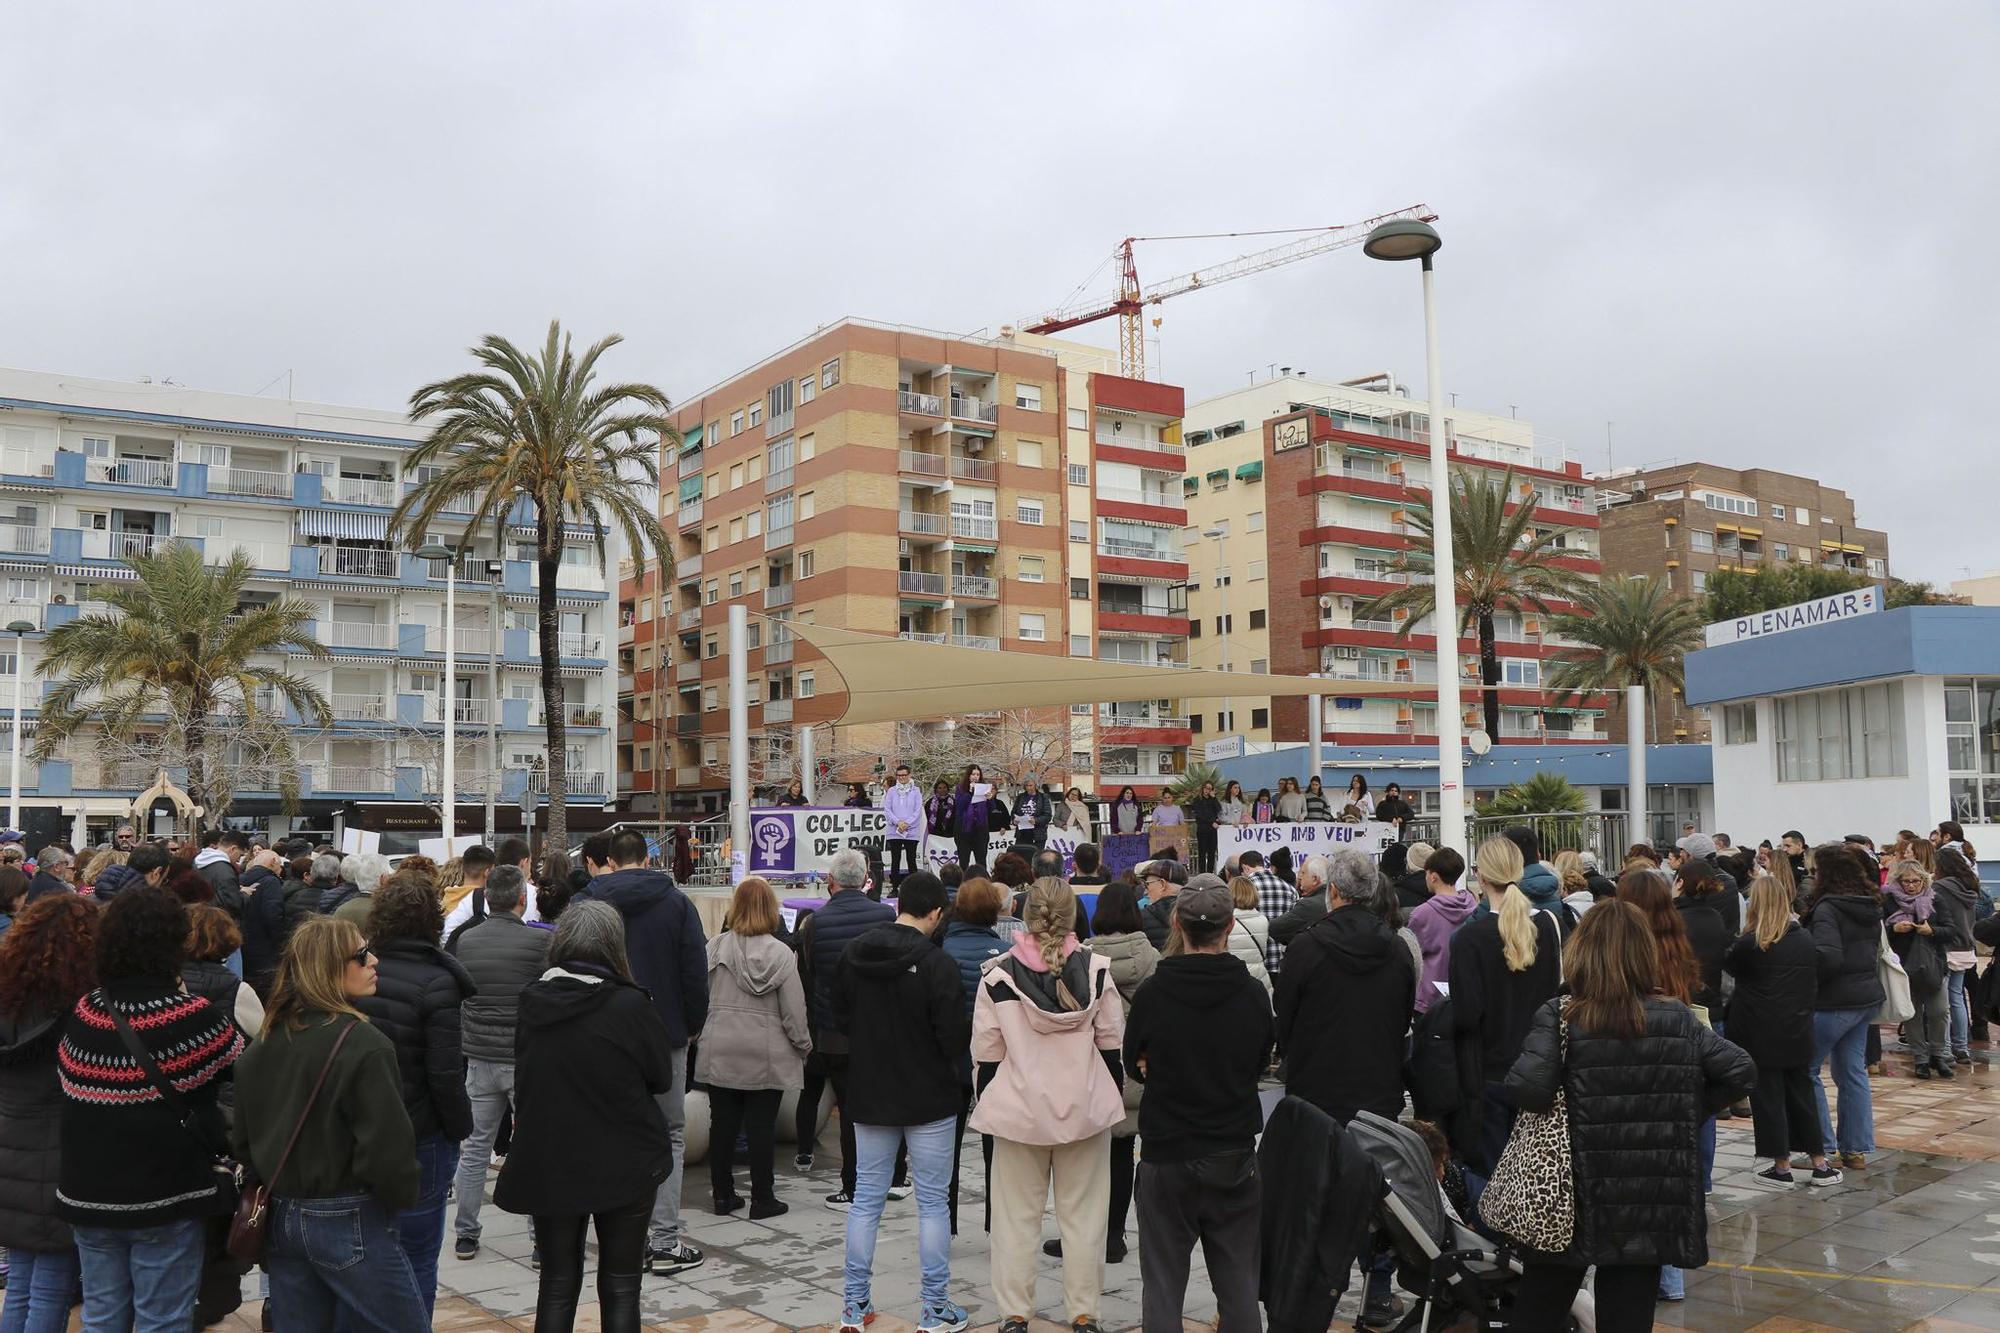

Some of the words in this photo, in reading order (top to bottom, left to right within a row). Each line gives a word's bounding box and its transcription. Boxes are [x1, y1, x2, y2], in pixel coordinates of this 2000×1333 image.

[1736, 594, 1858, 639] PLENAMAR
[806, 813, 886, 834] COL·LEC
[988, 838, 1014, 850] stás
[1235, 827, 1282, 843] JOVES
[1291, 826, 1315, 842] AMB
[1324, 826, 1351, 843] VEU
[814, 837, 839, 856] DE
[848, 835, 886, 852] DON
